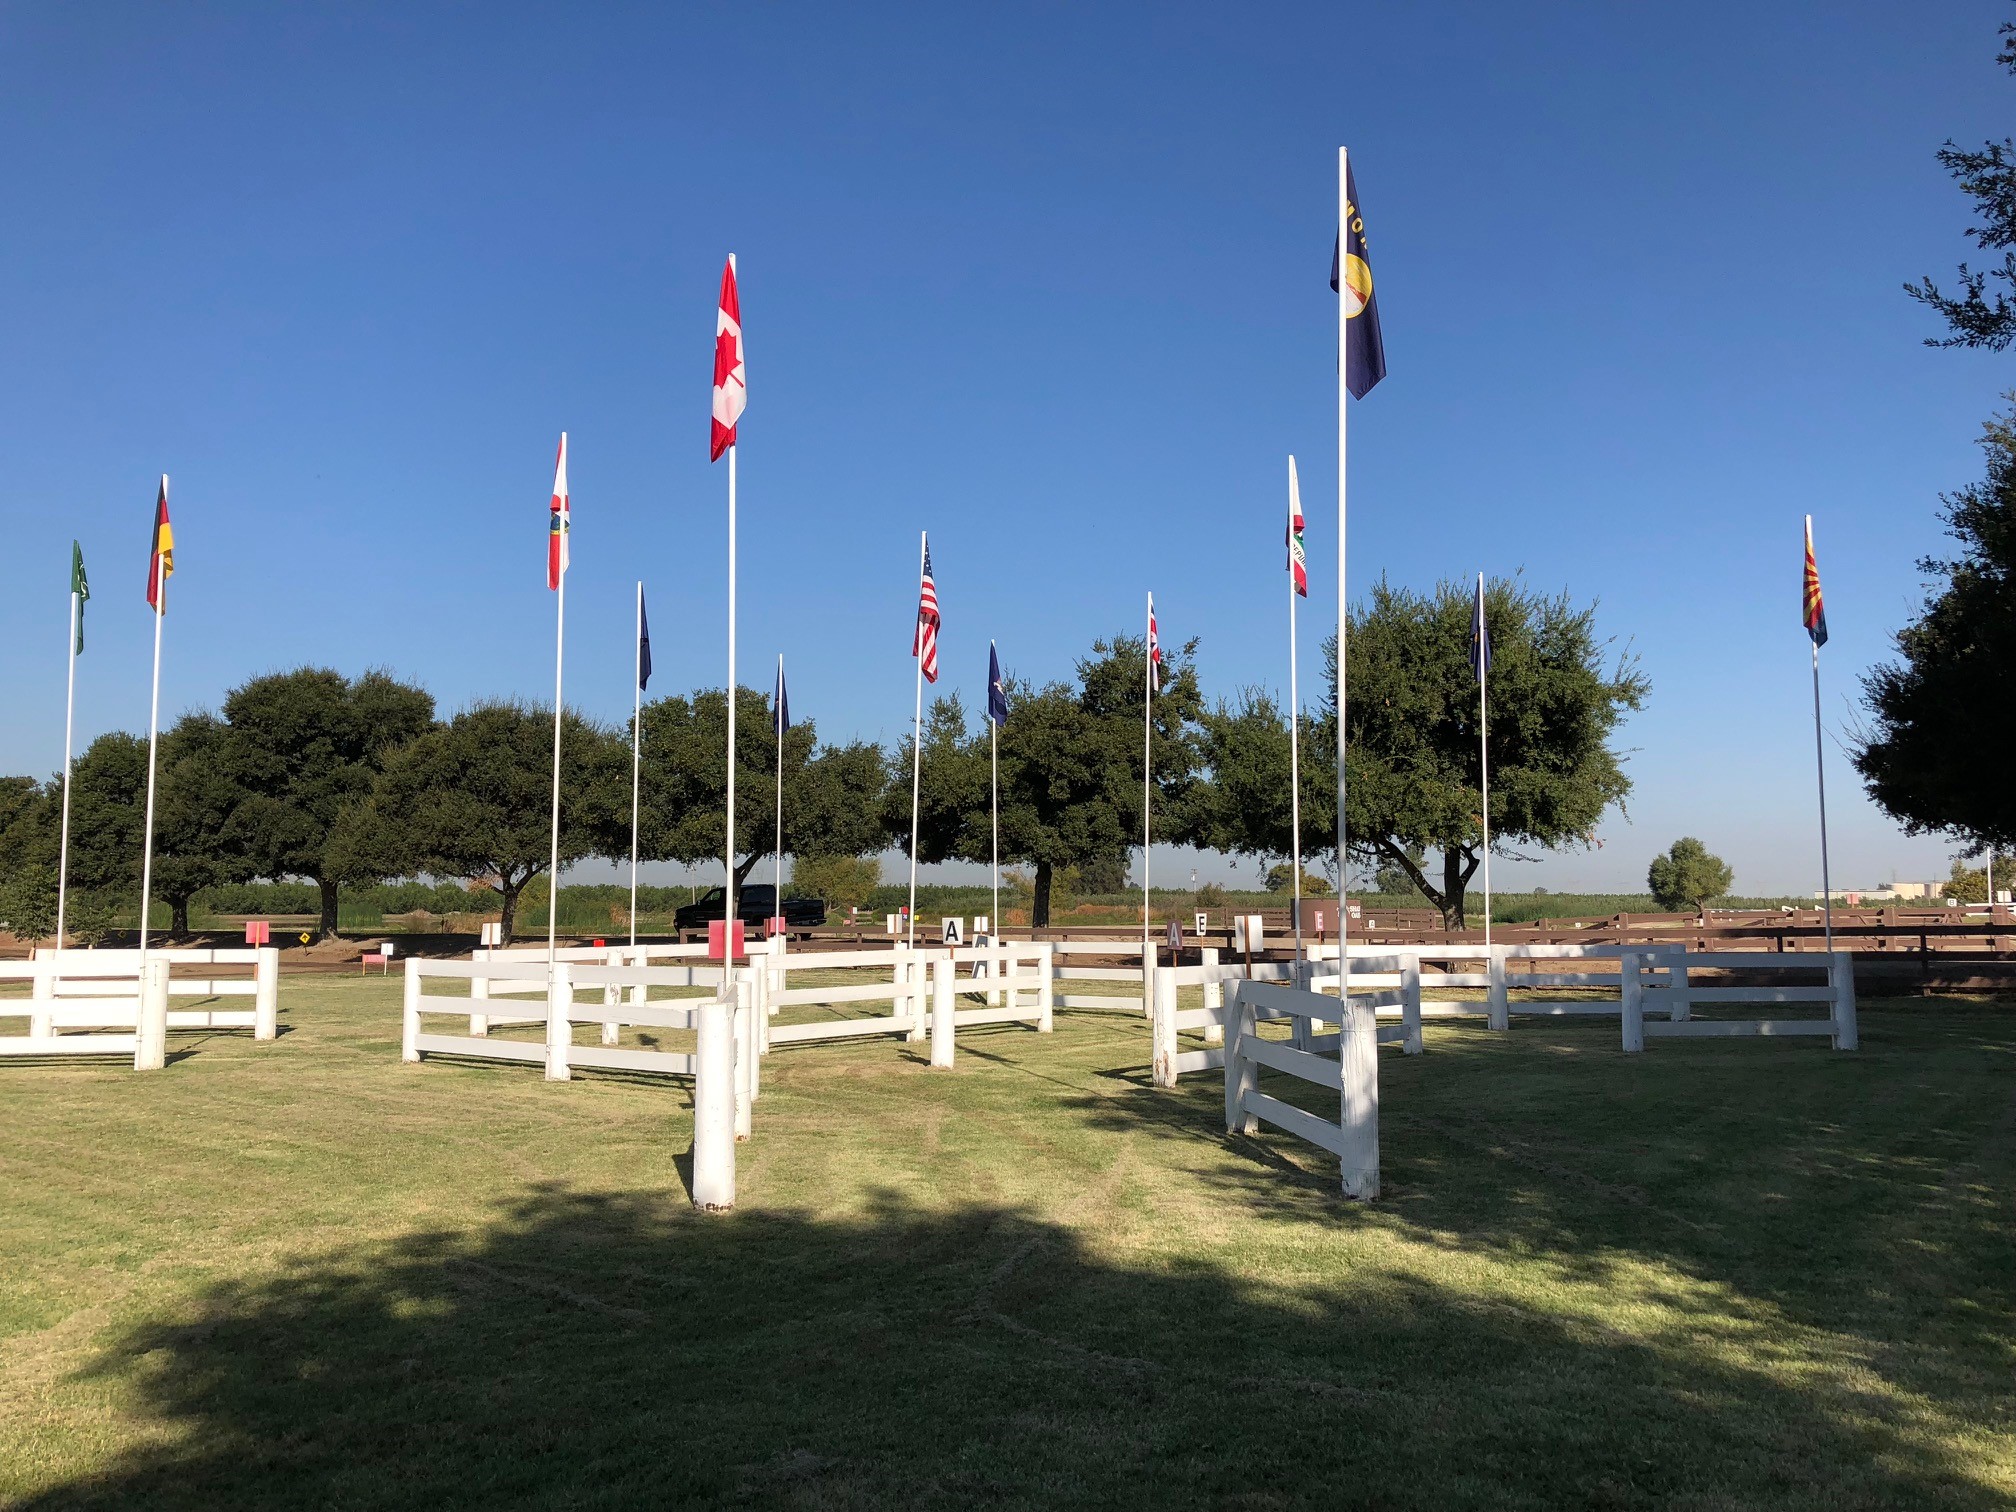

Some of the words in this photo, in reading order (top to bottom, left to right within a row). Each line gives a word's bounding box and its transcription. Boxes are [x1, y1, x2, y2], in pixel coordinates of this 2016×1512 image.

[1199, 916, 1205, 932] E
[1317, 912, 1323, 929] E
[945, 920, 959, 941] A
[1169, 922, 1180, 946] A
